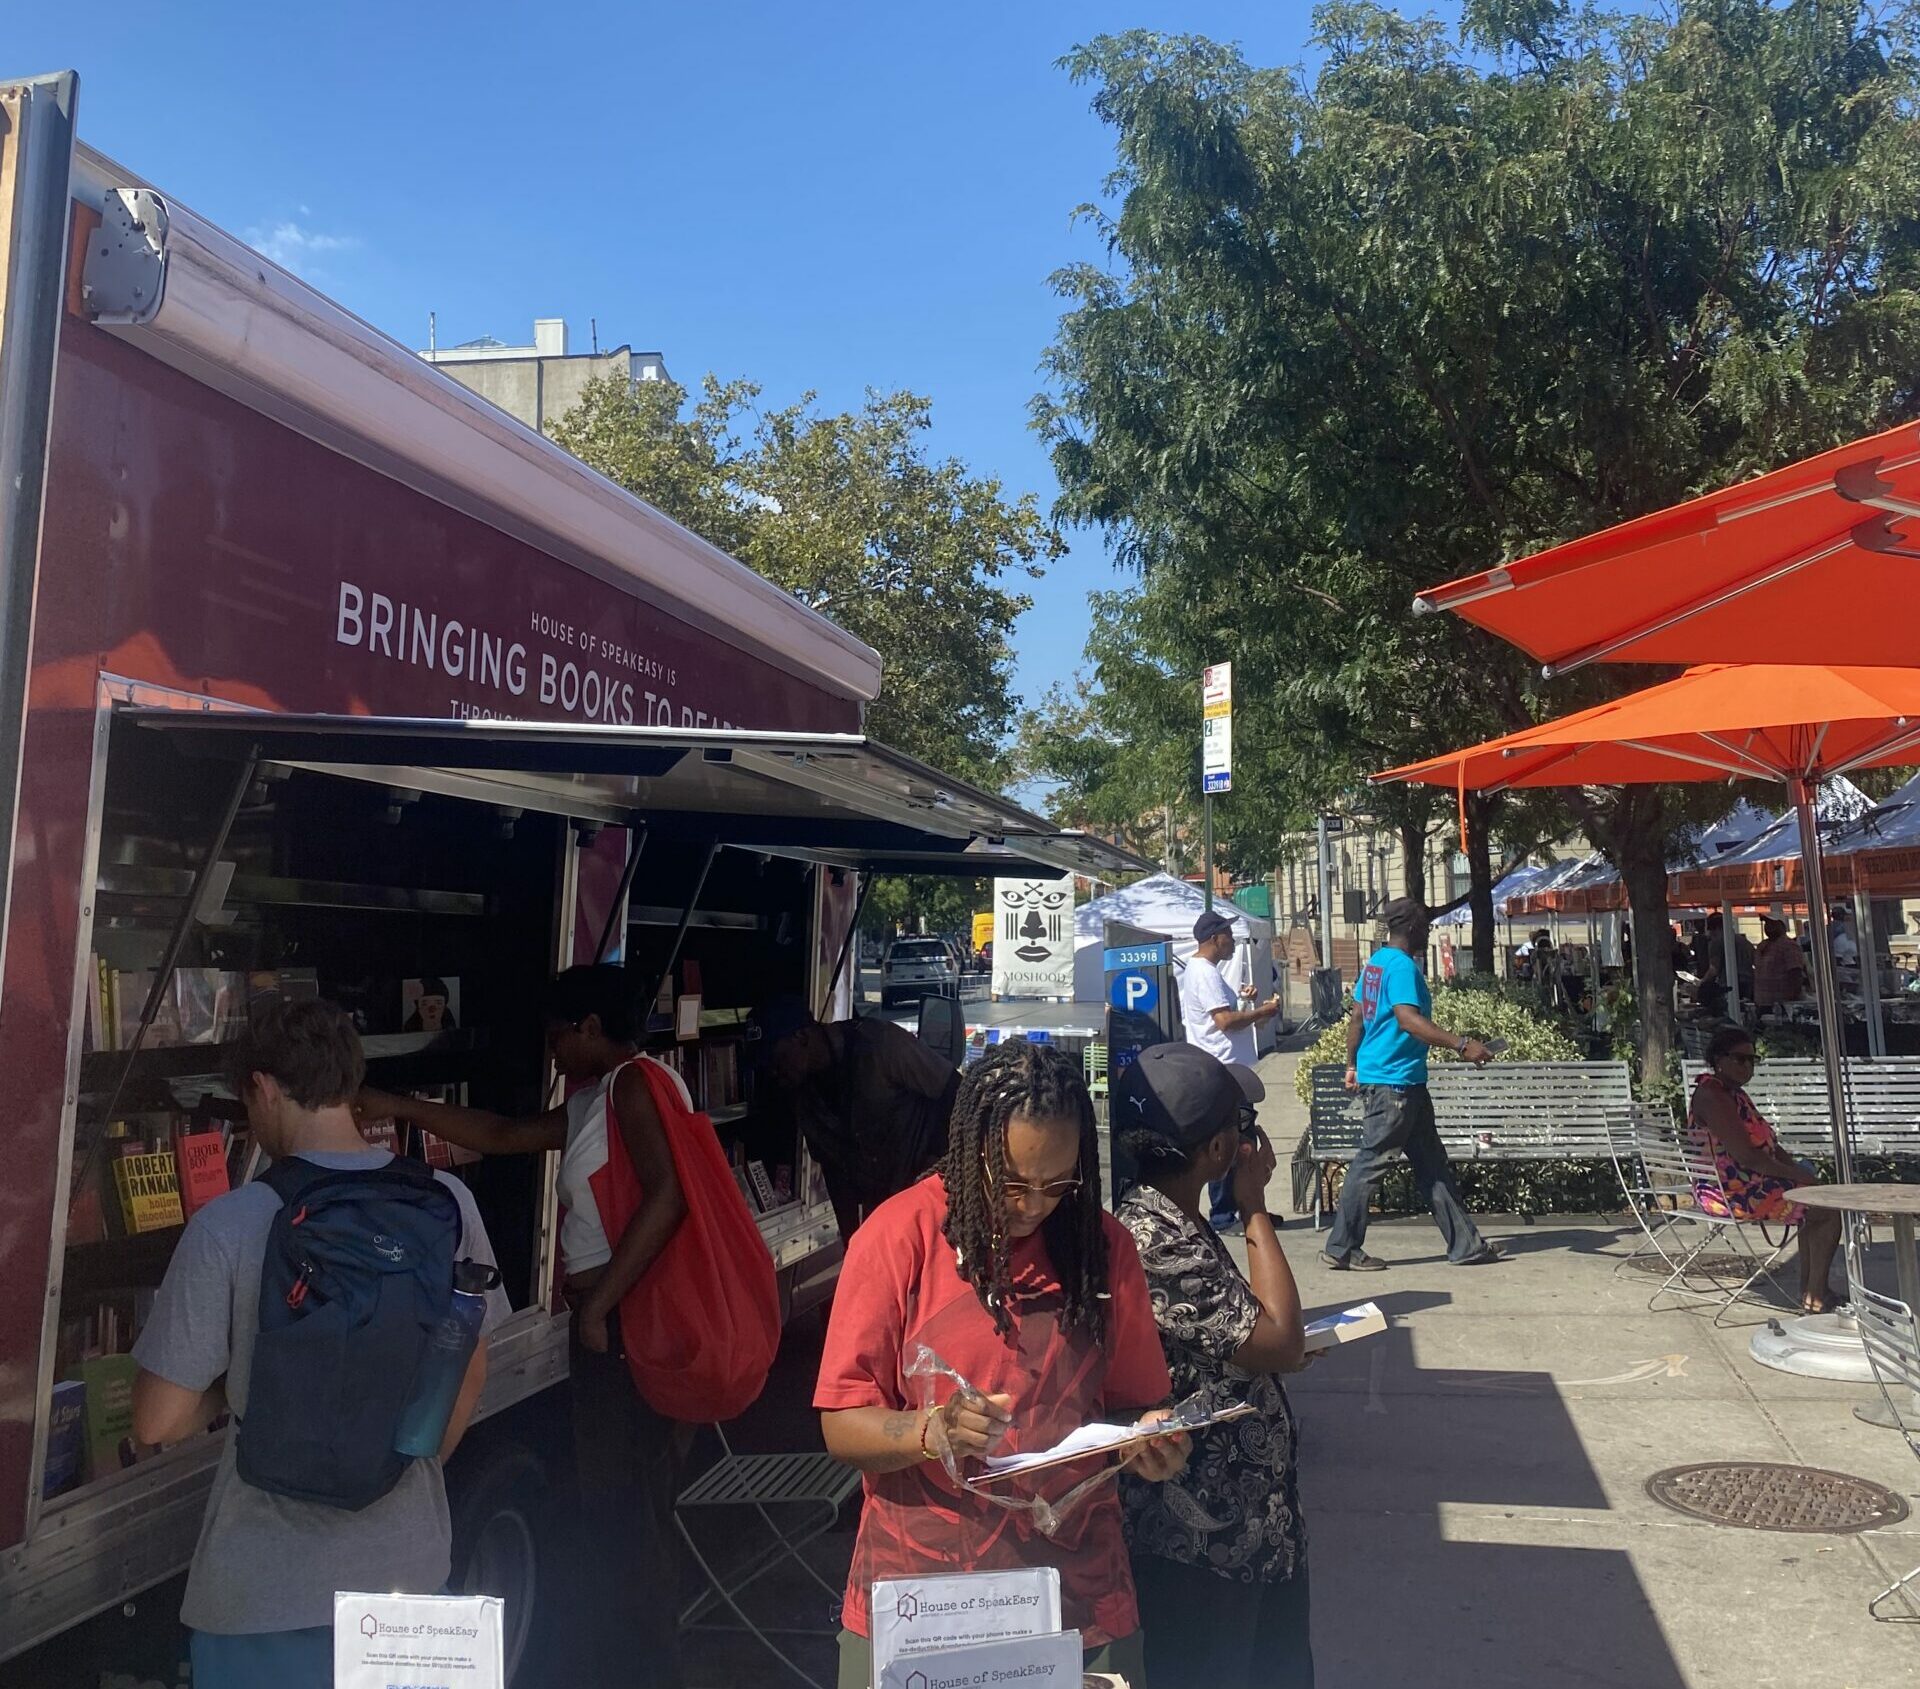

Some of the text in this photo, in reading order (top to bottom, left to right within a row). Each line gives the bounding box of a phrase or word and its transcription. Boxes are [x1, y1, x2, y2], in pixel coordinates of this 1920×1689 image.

[336, 581, 672, 727] BRINGING BOOKS TO
[531, 611, 676, 687] HOUSE OF SPEAKEASY IS
[1120, 951, 1158, 963] 333918
[1002, 970, 1066, 984] MOSHOOD
[1126, 976, 1149, 1011] P
[188, 1143, 220, 1159] CHOIR
[125, 1153, 173, 1177] ROBERT
[190, 1156, 207, 1169] BOY
[130, 1174, 179, 1197] RANKIN
[920, 1594, 1040, 1613] House of SpeakEasy
[379, 1623, 410, 1634] House
[412, 1624, 425, 1634] of
[427, 1625, 479, 1638] SpeakEasy
[930, 1664, 1056, 1689] House of SpeakEasy
